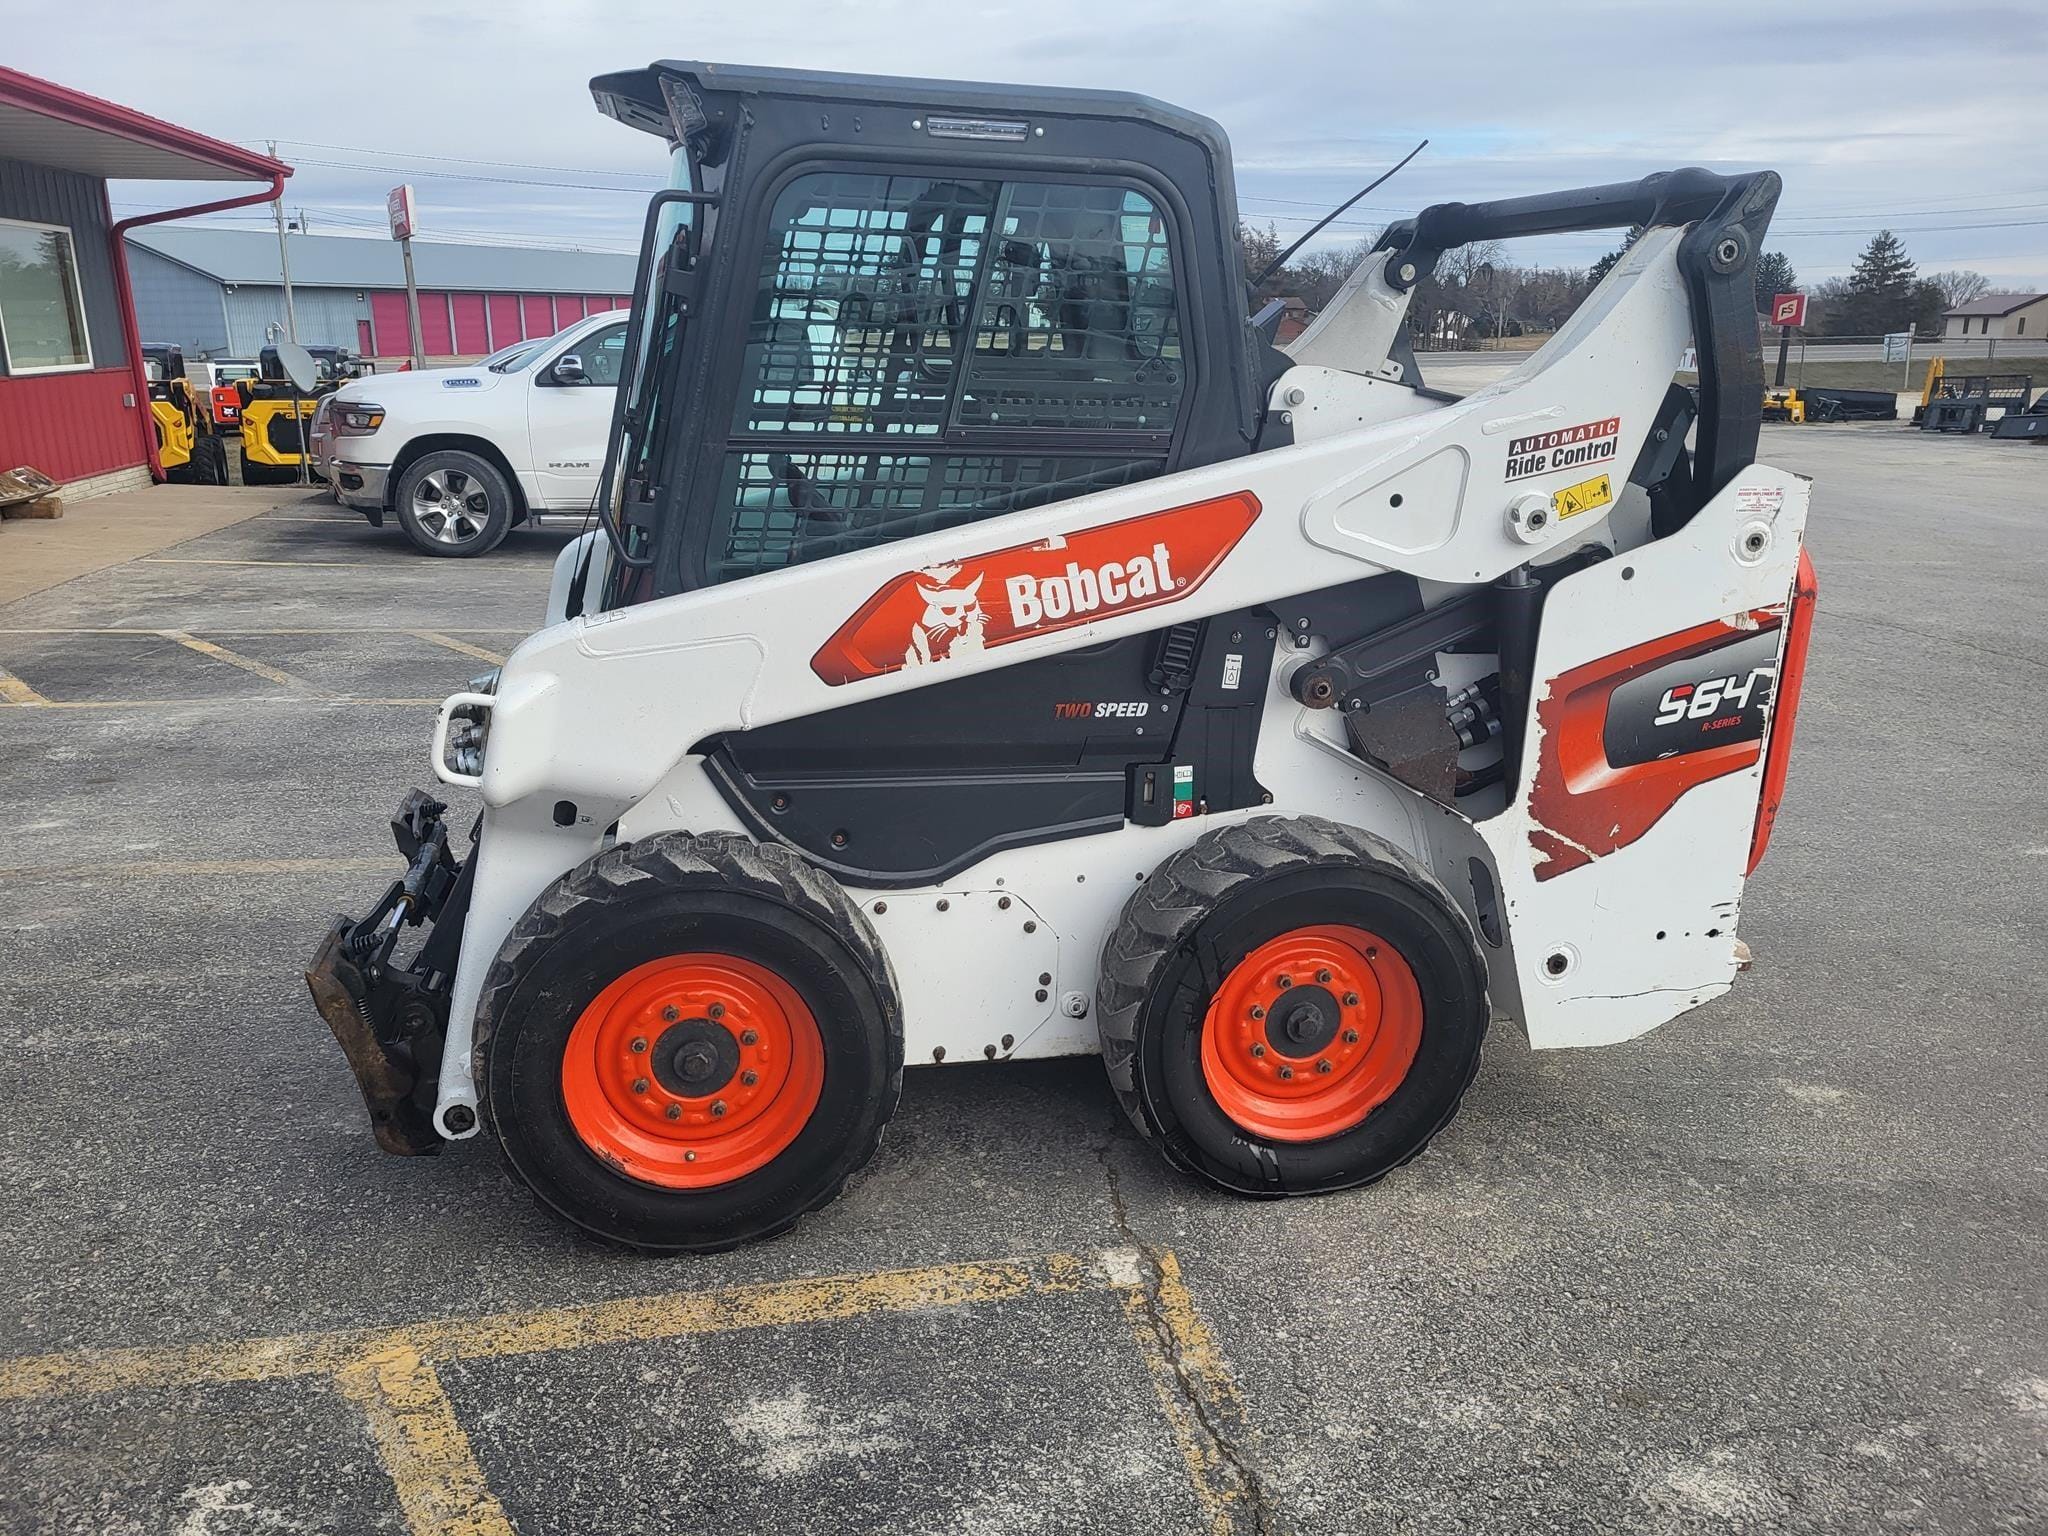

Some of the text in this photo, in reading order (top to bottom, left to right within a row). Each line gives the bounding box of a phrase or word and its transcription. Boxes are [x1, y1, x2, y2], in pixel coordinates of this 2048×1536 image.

[1781, 304, 1794, 317] FS
[1512, 420, 1616, 455] AUTOMATIC
[1505, 437, 1618, 478] Ride Control
[1006, 542, 1176, 628] Bobcat
[1054, 702, 1149, 719] TWO SPEED
[1653, 671, 1758, 727] S64
[1702, 715, 1742, 732] R-SERIES
